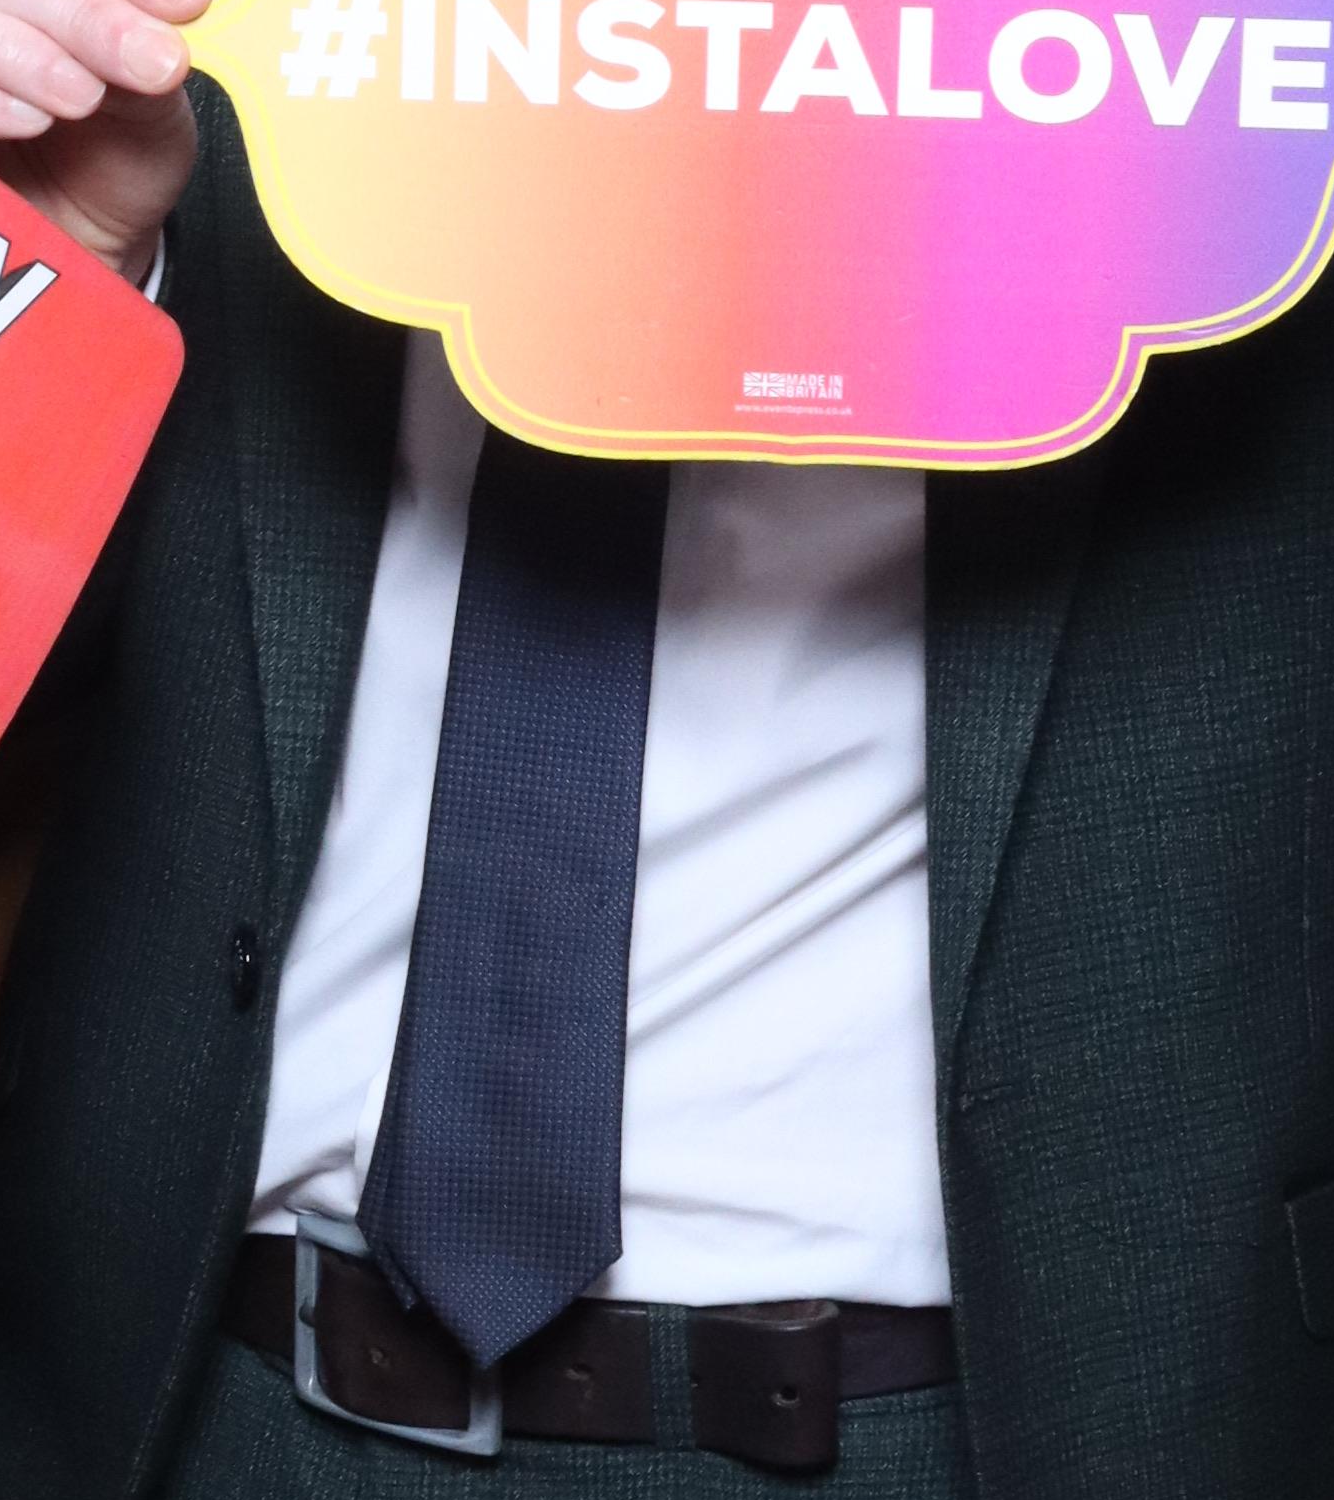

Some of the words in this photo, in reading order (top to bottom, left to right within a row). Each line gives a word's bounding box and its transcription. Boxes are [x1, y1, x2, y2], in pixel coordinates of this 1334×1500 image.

[787, 374, 825, 385] MADE
[828, 375, 843, 386] IN
[787, 386, 843, 399] BRITAIN
